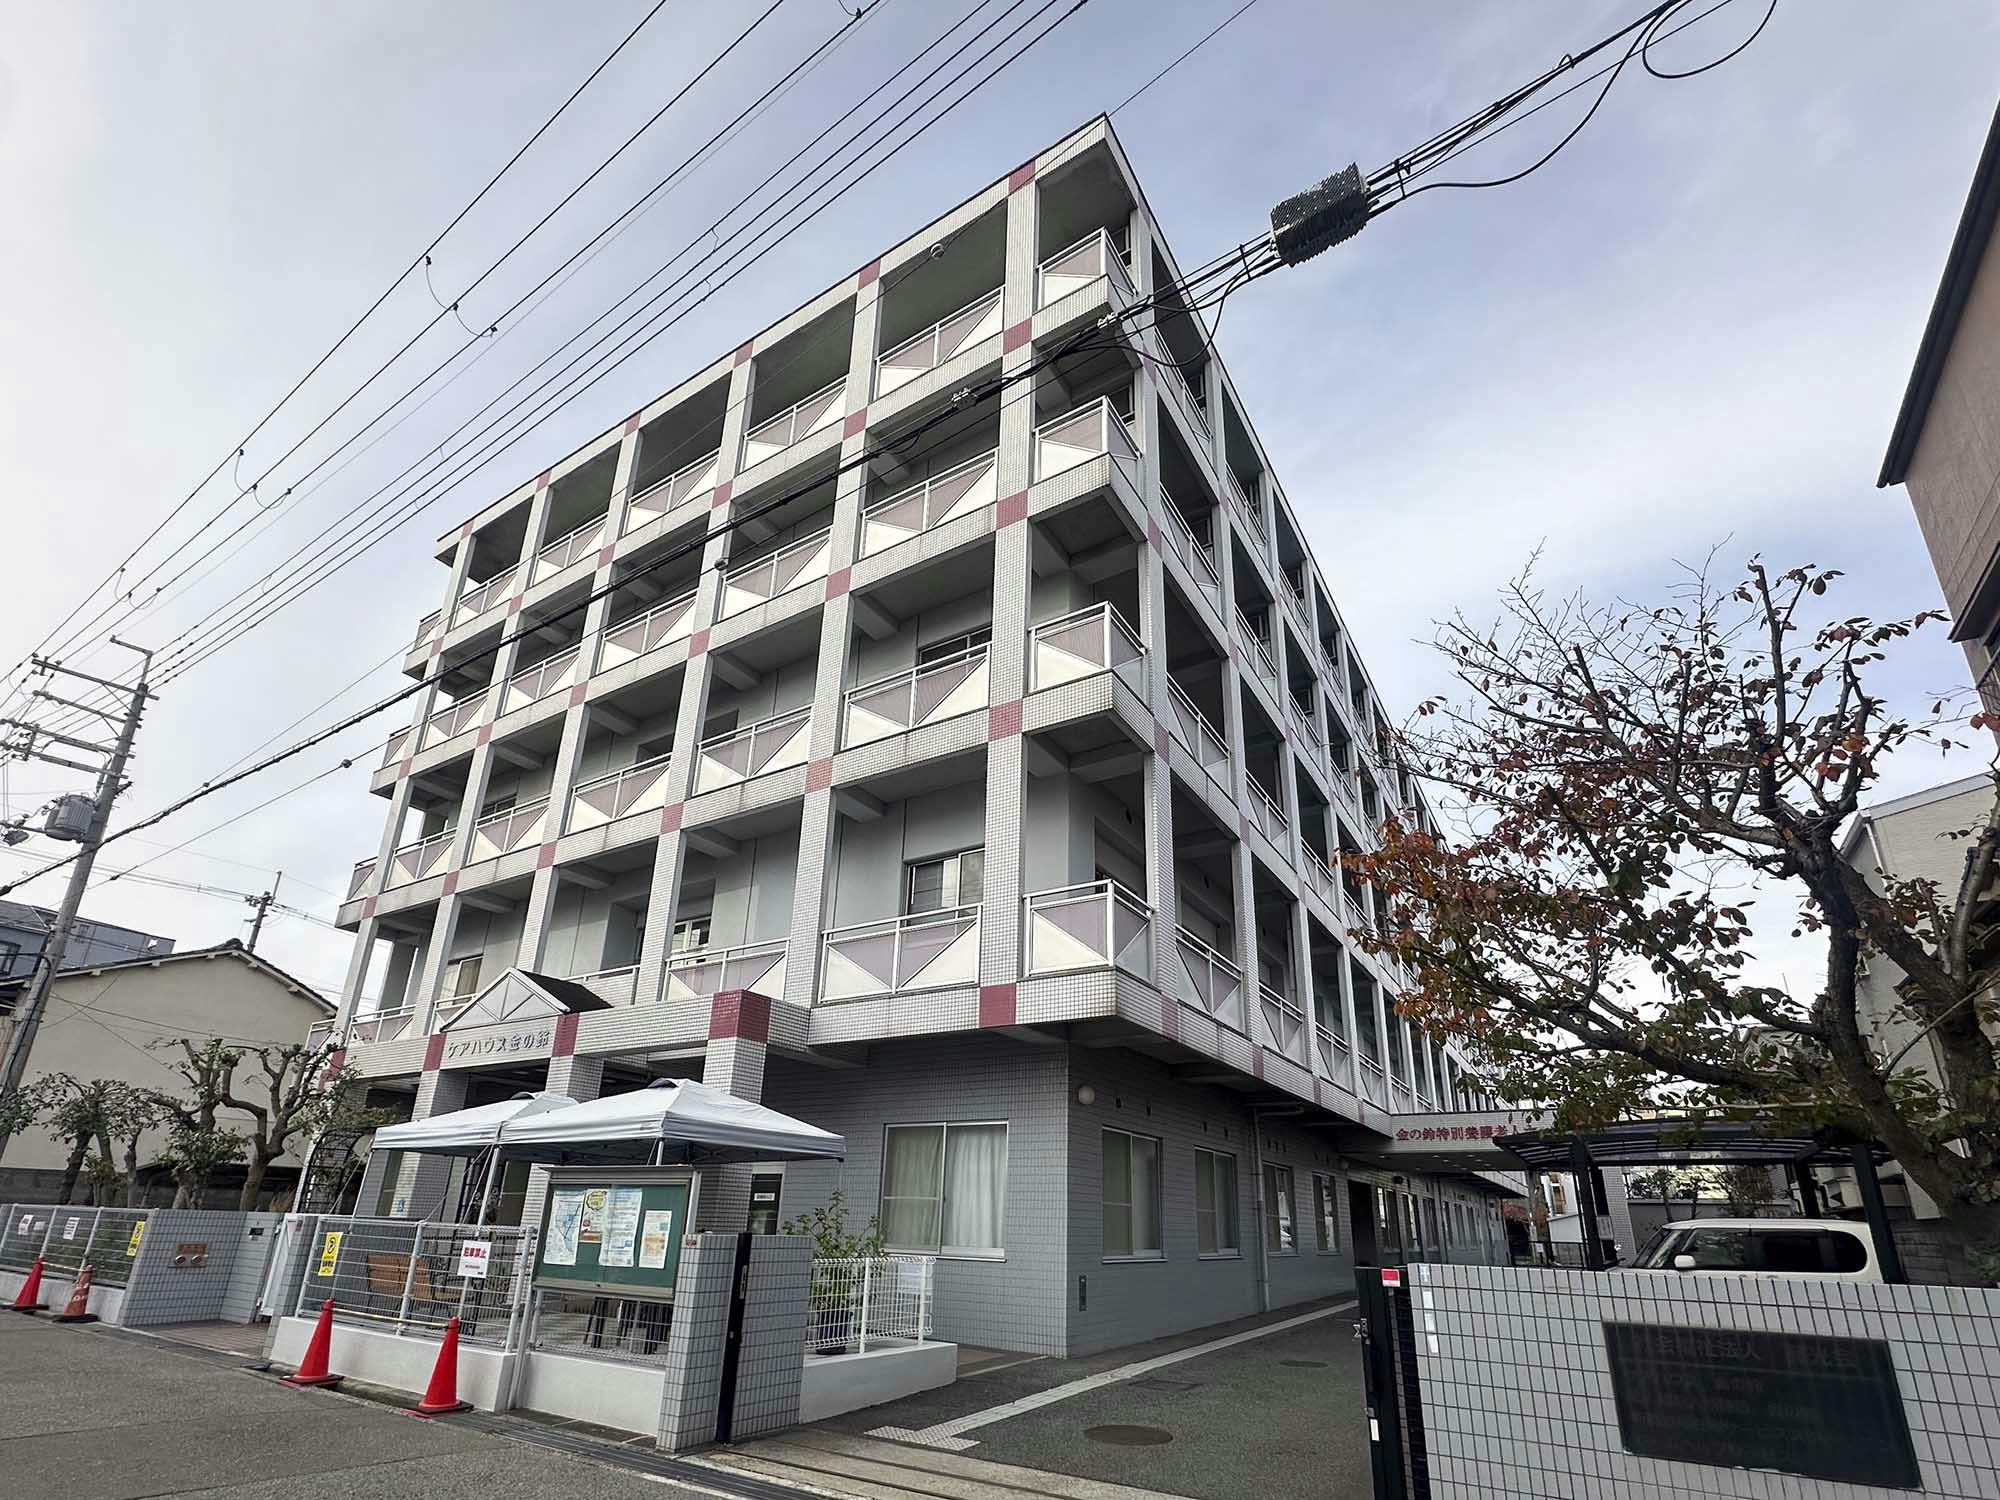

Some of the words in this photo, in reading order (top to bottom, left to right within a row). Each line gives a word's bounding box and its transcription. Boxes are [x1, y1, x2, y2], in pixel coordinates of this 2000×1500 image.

[448, 1031, 550, 1058] ケアハウス金の鈴
[1396, 1125, 1537, 1141] 金の鈴特別養護老人
